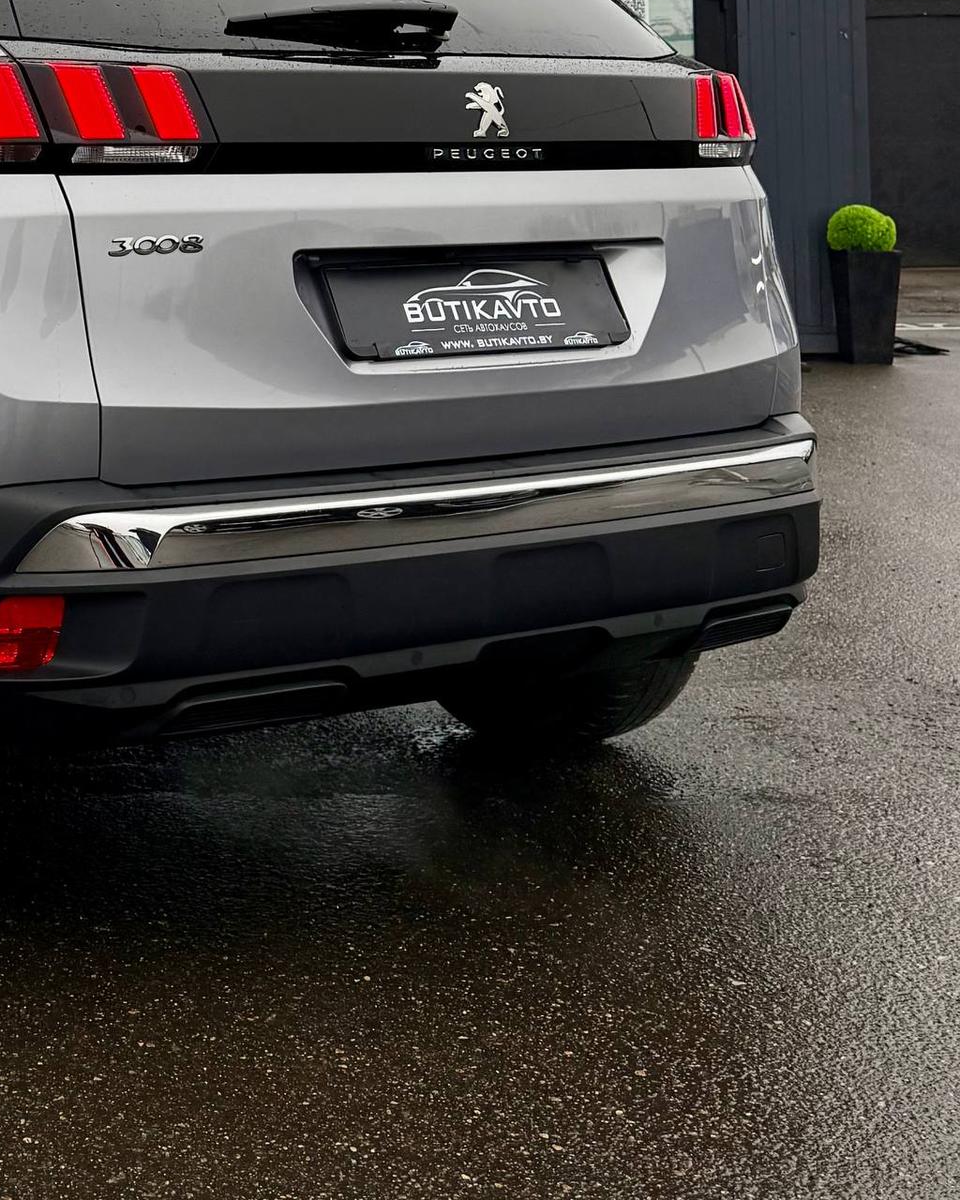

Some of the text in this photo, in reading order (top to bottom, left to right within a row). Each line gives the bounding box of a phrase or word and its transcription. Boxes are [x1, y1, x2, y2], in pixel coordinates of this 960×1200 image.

[433, 147, 543, 161] PEUGEOT
[107, 234, 204, 258] 3008
[402, 297, 562, 324] BUTIKAVTO
[453, 321, 529, 334] СЕТЬ АВТОХАУСОВ
[440, 334, 554, 351] WWW. BUTIKAVTO.BY
[563, 334, 599, 345] BUTIKAVTO
[394, 344, 435, 356] BUTIKAVTO
